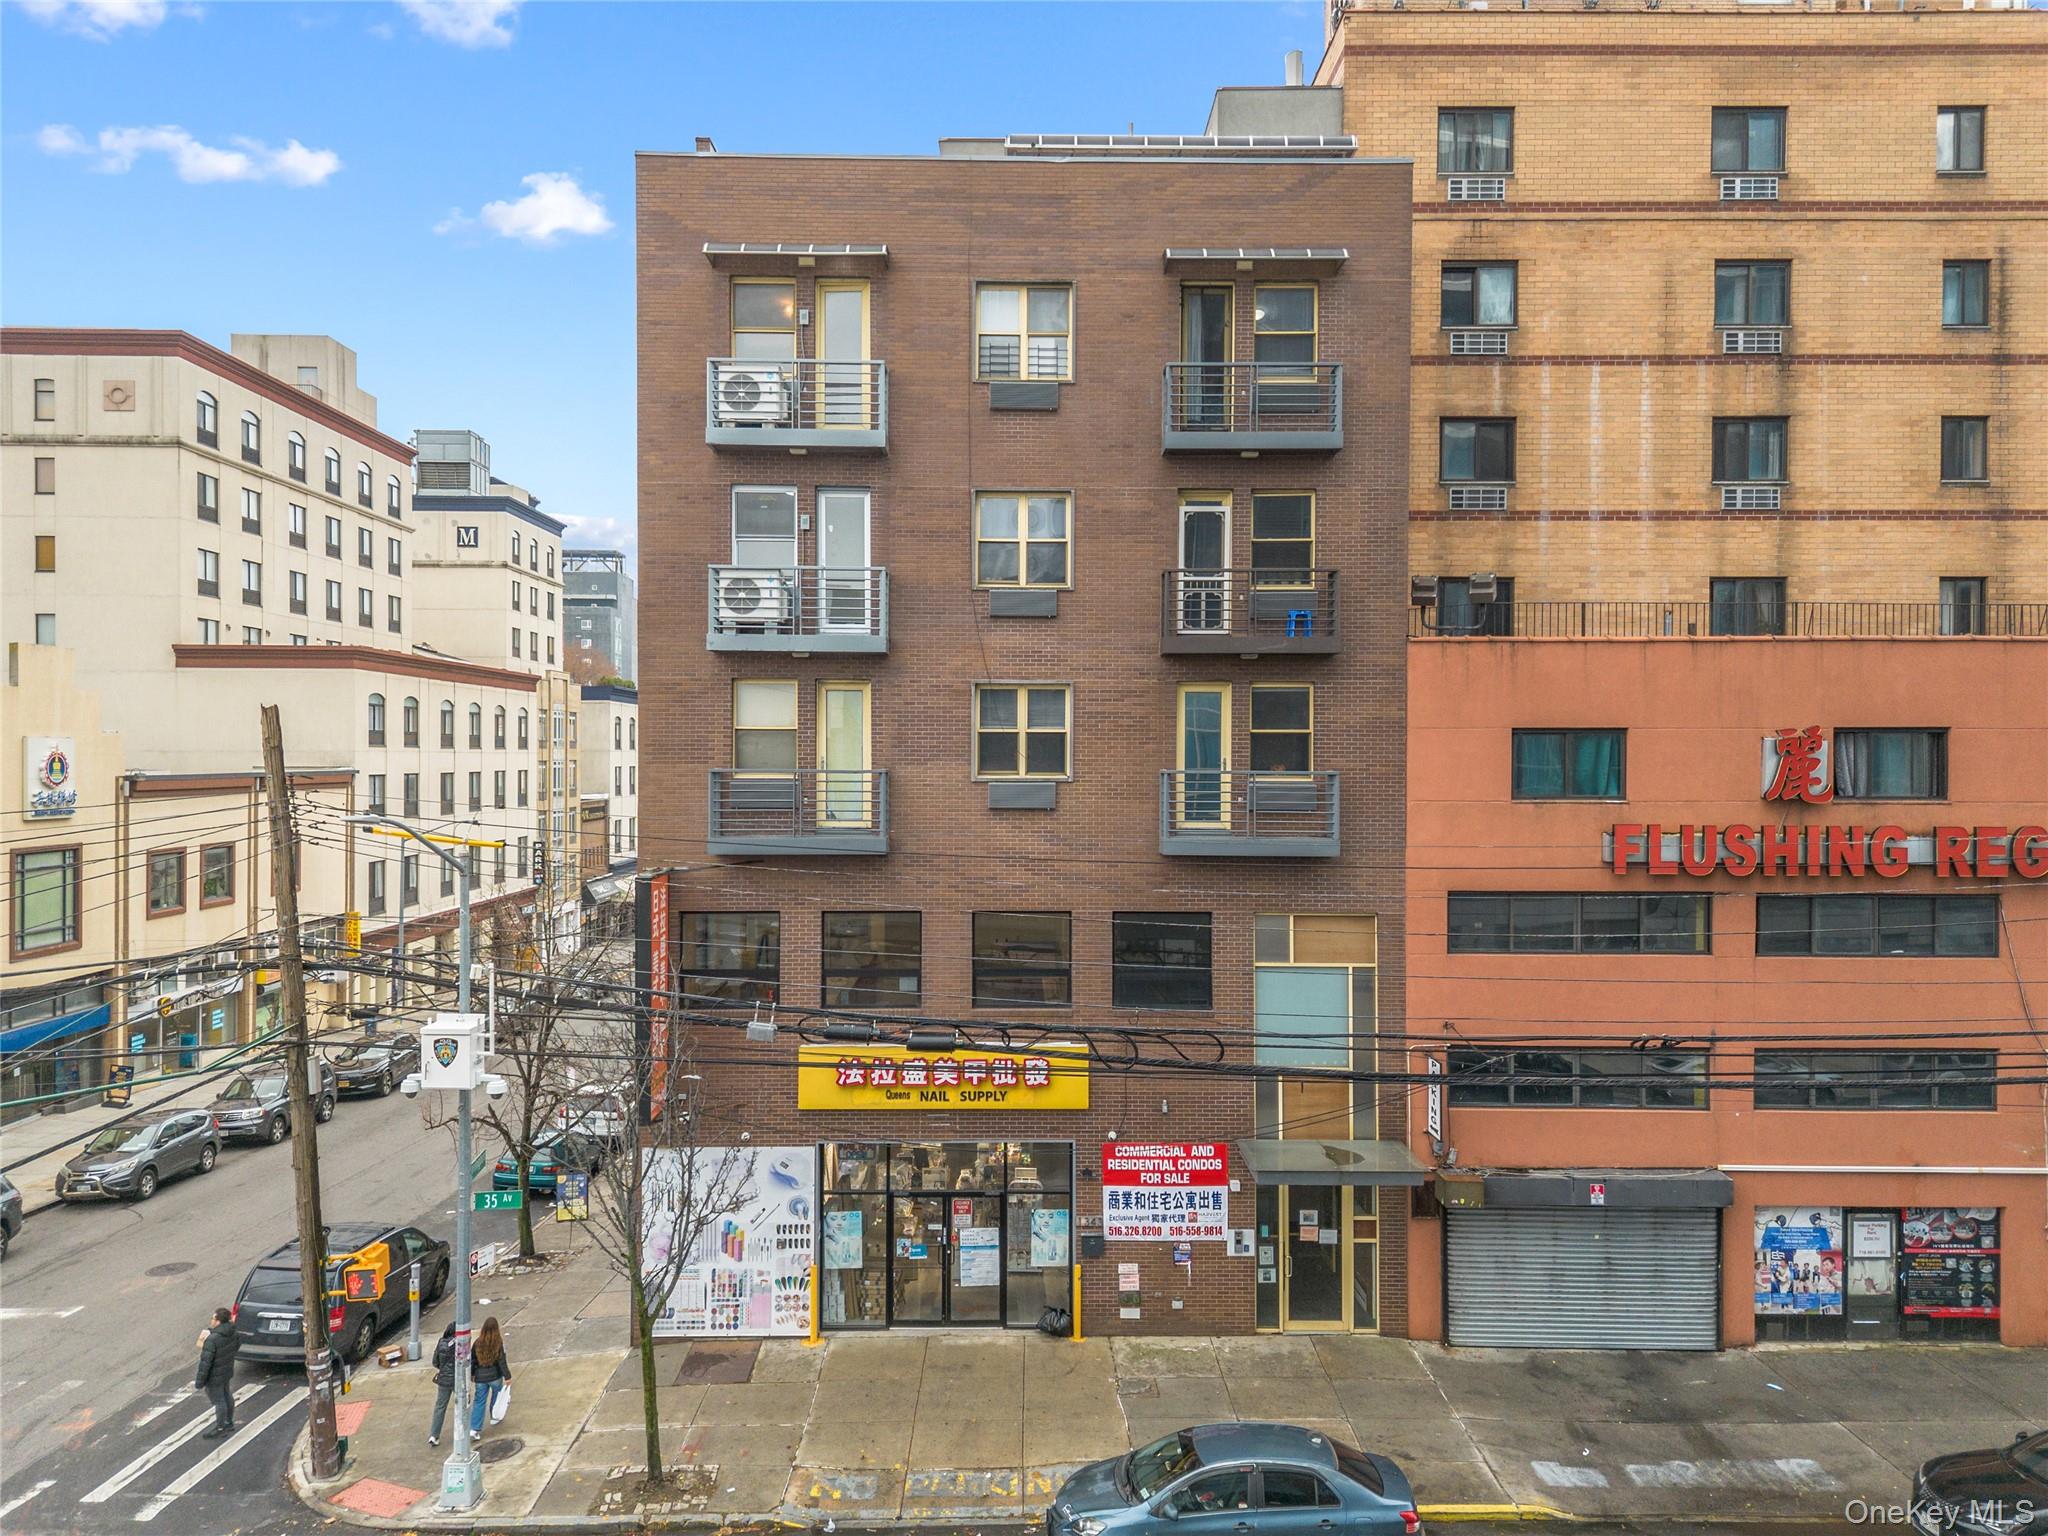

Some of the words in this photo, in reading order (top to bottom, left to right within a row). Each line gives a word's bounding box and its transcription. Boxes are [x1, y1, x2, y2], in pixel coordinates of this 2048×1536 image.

[459, 528, 476, 545] M
[1612, 823, 1909, 878] FLUSHING
[1933, 825, 2048, 878] REG
[837, 1056, 1050, 1087] 法拉盛美甲批發
[885, 1089, 911, 1101] Queens
[919, 1091, 949, 1102] NAIL
[960, 1091, 1008, 1102] SUPPLY
[1115, 1146, 1186, 1157] COMMERCIAL
[1191, 1146, 1214, 1156] AND
[1107, 1159, 1175, 1170] RESIDENTIAL
[1178, 1159, 1222, 1169] CONDOS
[1140, 1173, 1161, 1184] FOR
[1163, 1173, 1190, 1184] SALE
[484, 1194, 497, 1208] 35
[503, 1194, 512, 1202] Av
[1108, 1191, 1222, 1210] 商業和住宅公寓出售
[1109, 1214, 1133, 1222] Exclusive
[1134, 1214, 1150, 1223] Agent
[1151, 1214, 1185, 1223] 獨家代理
[1108, 1226, 1162, 1236] 516.326.8200
[1169, 1226, 1223, 1236] 516-558-9814
